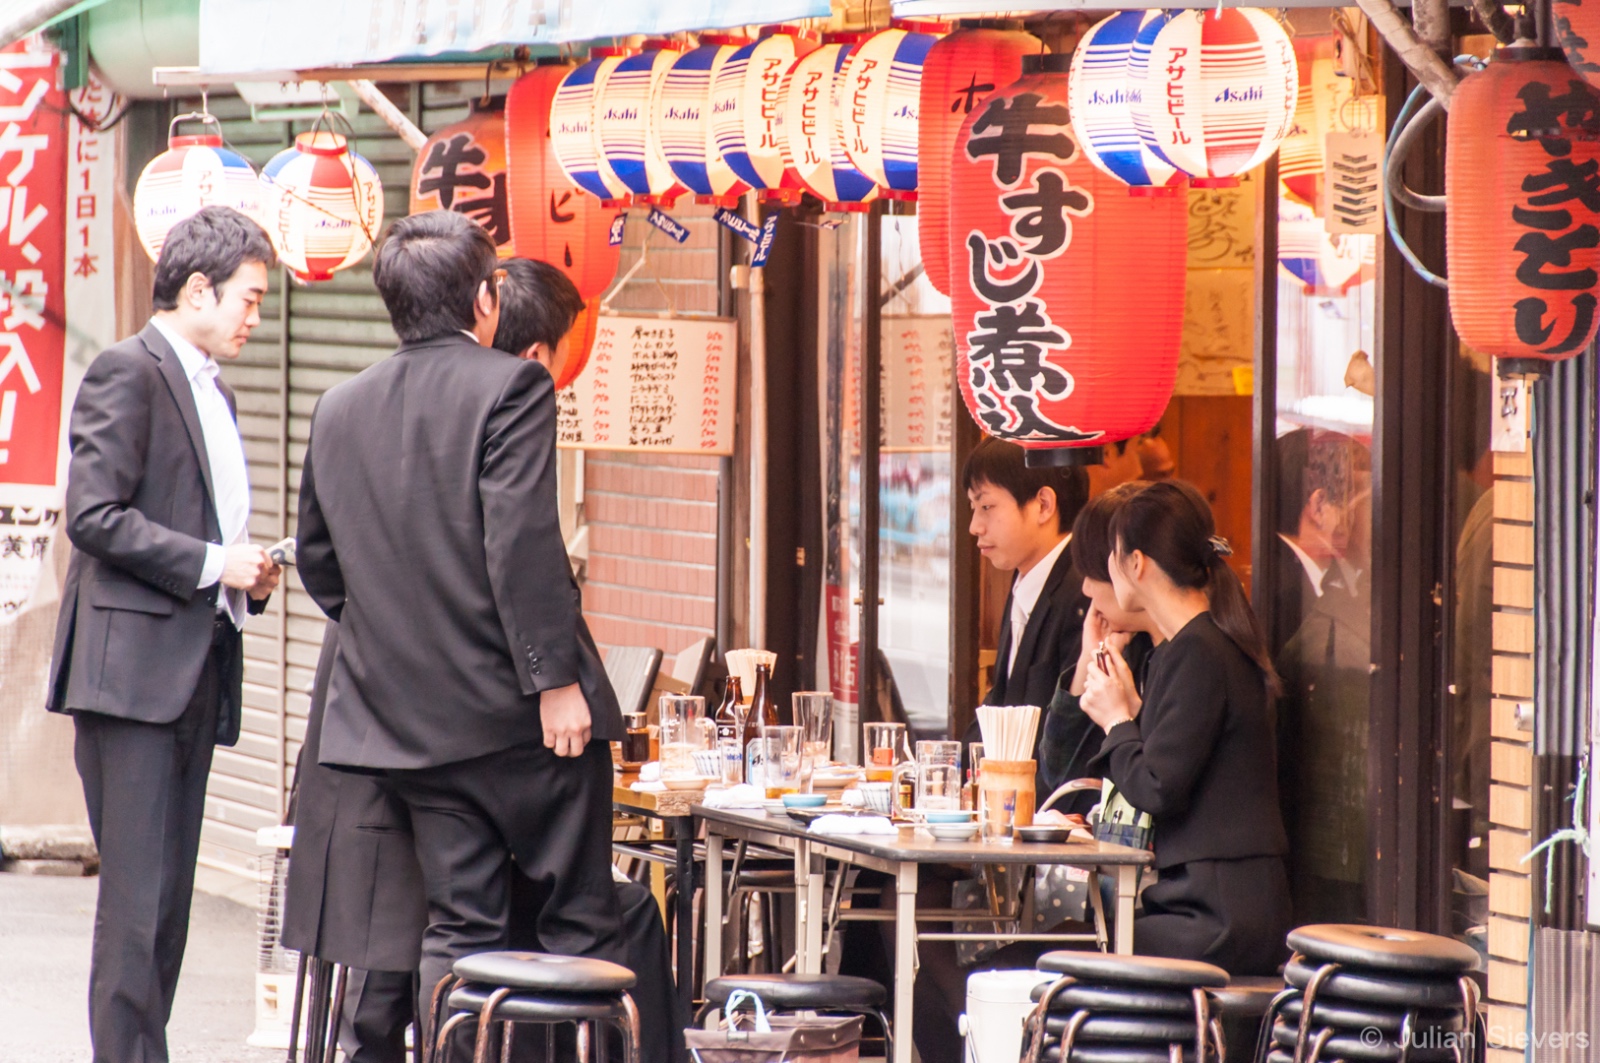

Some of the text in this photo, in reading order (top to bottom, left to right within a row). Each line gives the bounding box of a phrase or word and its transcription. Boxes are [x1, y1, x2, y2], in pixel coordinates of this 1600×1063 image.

[603, 107, 639, 121] Asahi
[664, 106, 699, 121] Asahi
[760, 58, 783, 149] アサヒビール
[801, 71, 823, 165] アサヒビール
[851, 58, 879, 154] アサヒビール
[1166, 47, 1192, 145] アサヒビール
[1215, 86, 1264, 104] Asahi
[558, 120, 589, 135] Asahi
[315, 218, 352, 229] Asahi
[967, 92, 1104, 442] 牛すじ煮込
